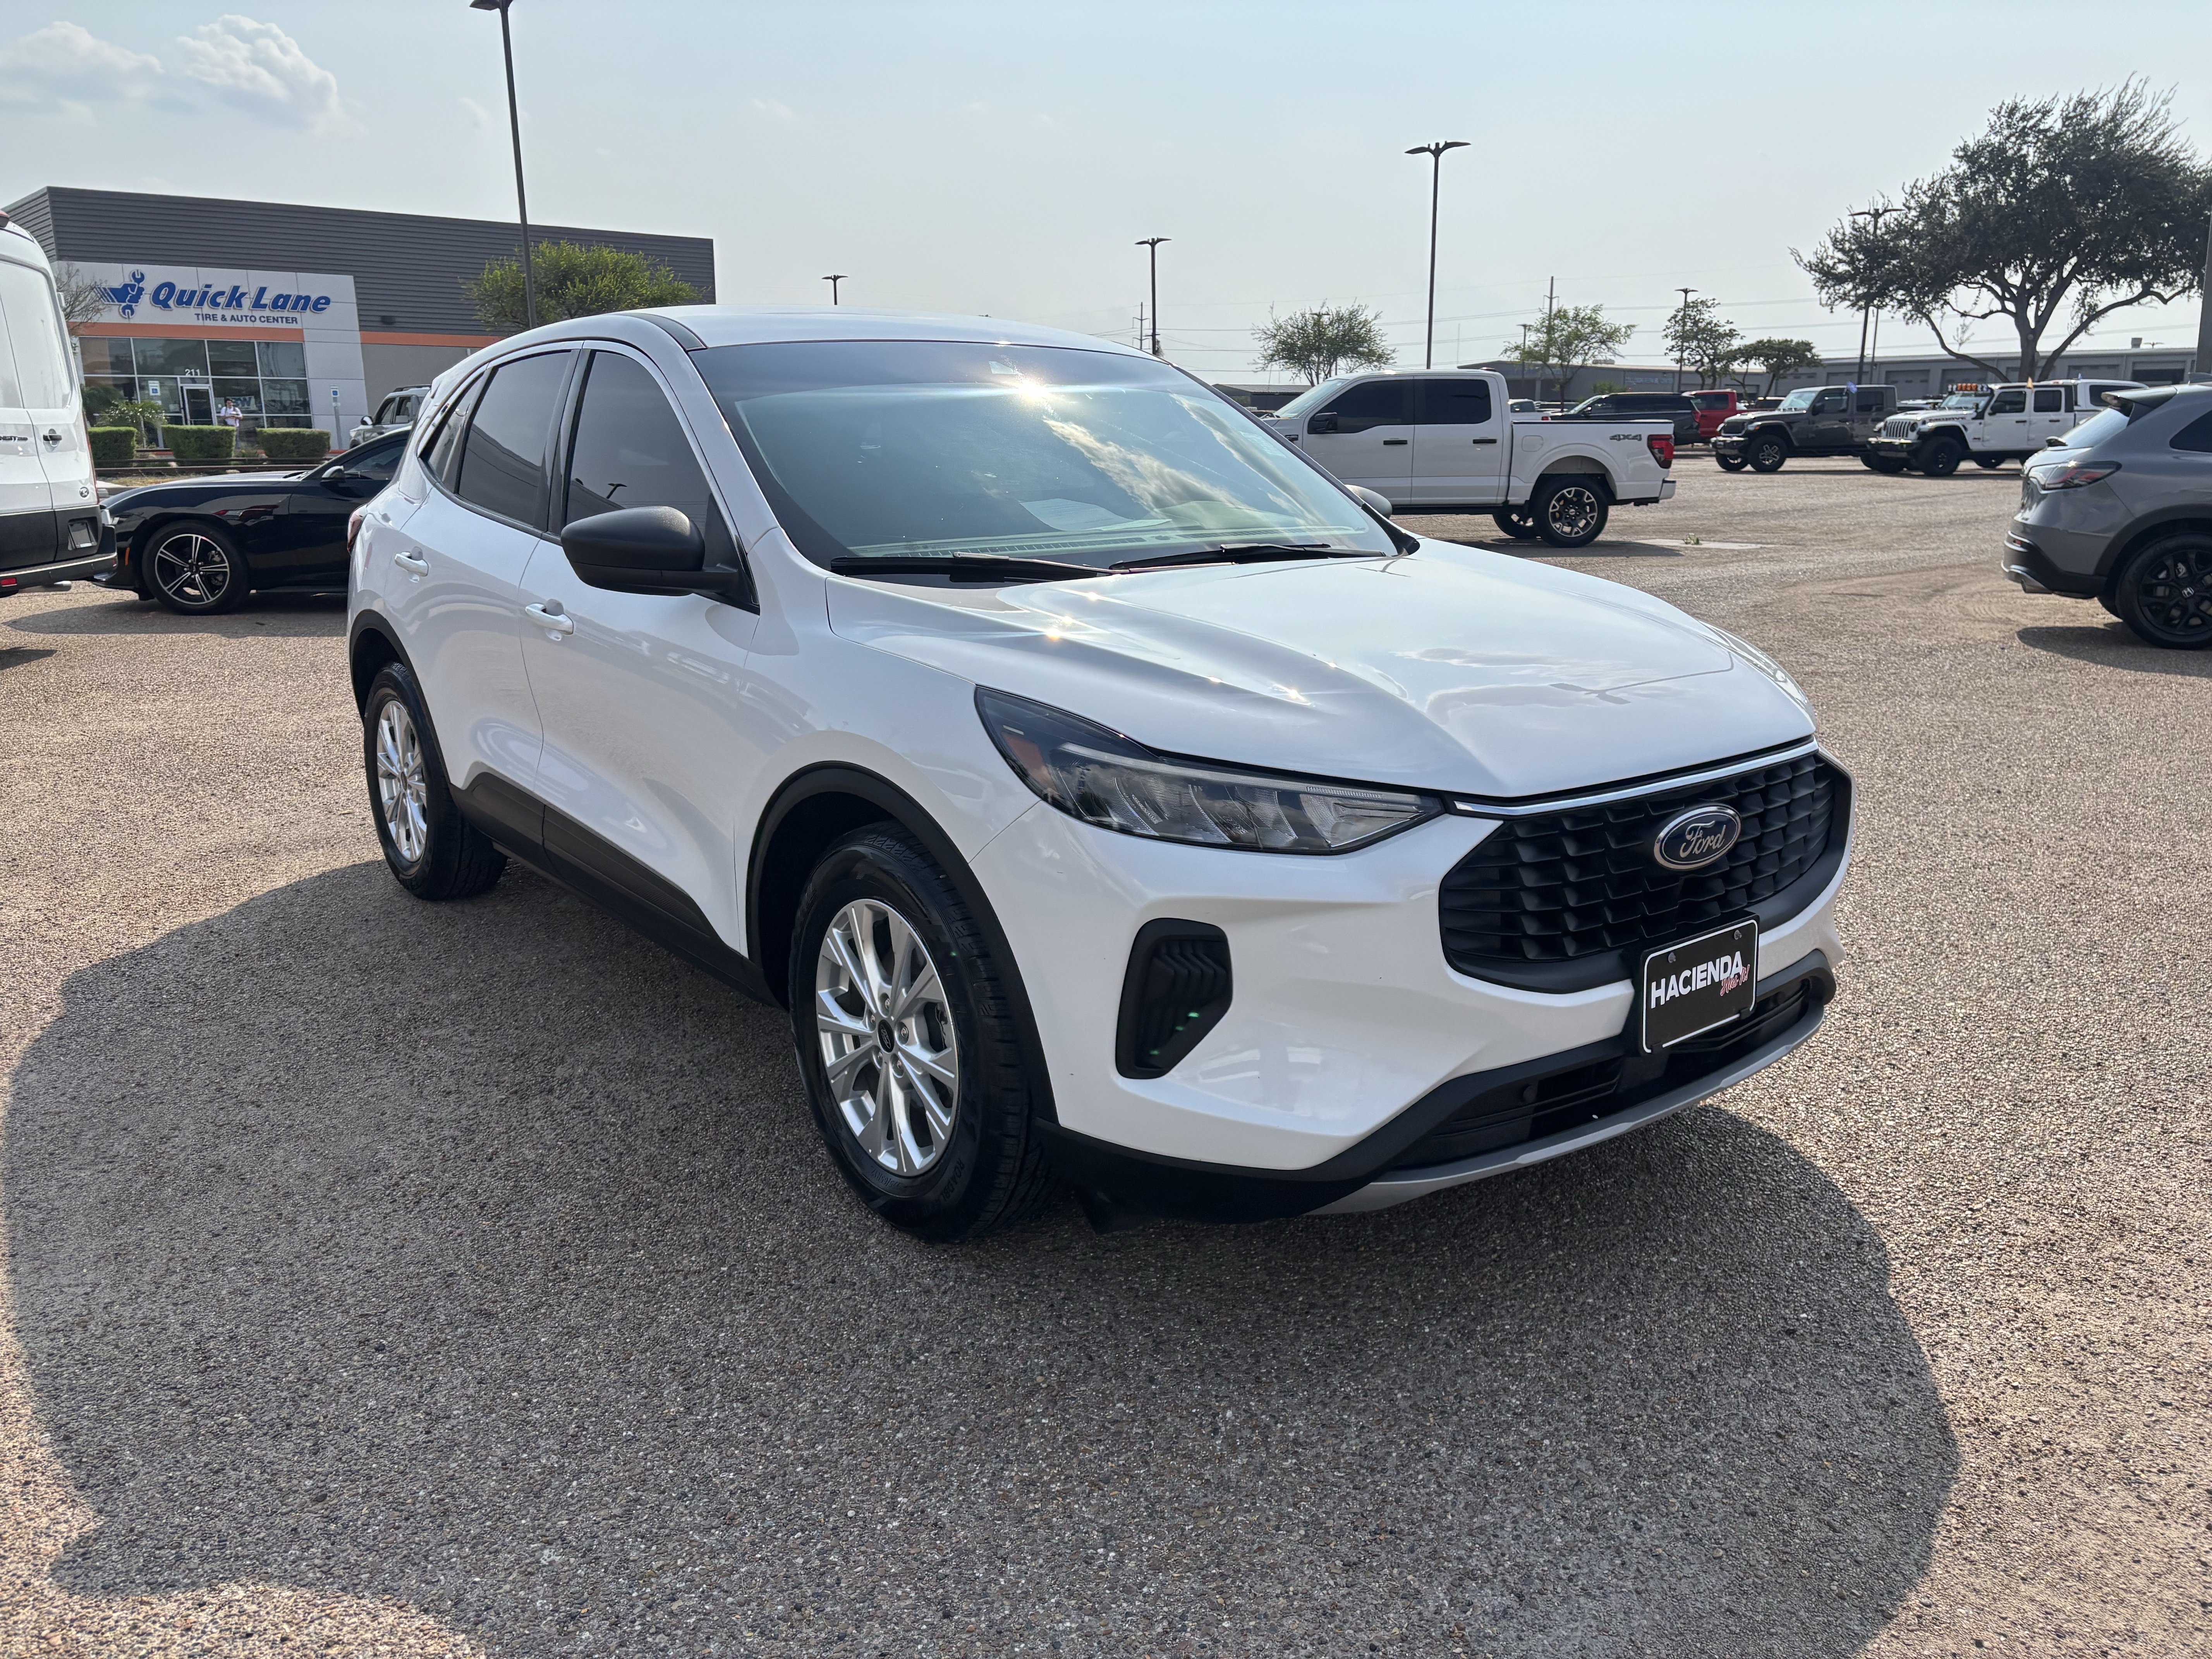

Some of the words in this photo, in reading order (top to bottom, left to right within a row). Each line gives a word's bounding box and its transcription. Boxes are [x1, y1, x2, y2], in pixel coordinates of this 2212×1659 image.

[151, 282, 249, 310] Quick
[251, 286, 331, 312] Lane
[194, 313, 218, 322] TIRE
[230, 315, 256, 323] AUTO
[259, 315, 298, 325] CENTER
[1680, 820, 1726, 858] Ford
[1651, 951, 1743, 1009] HACIENDA
